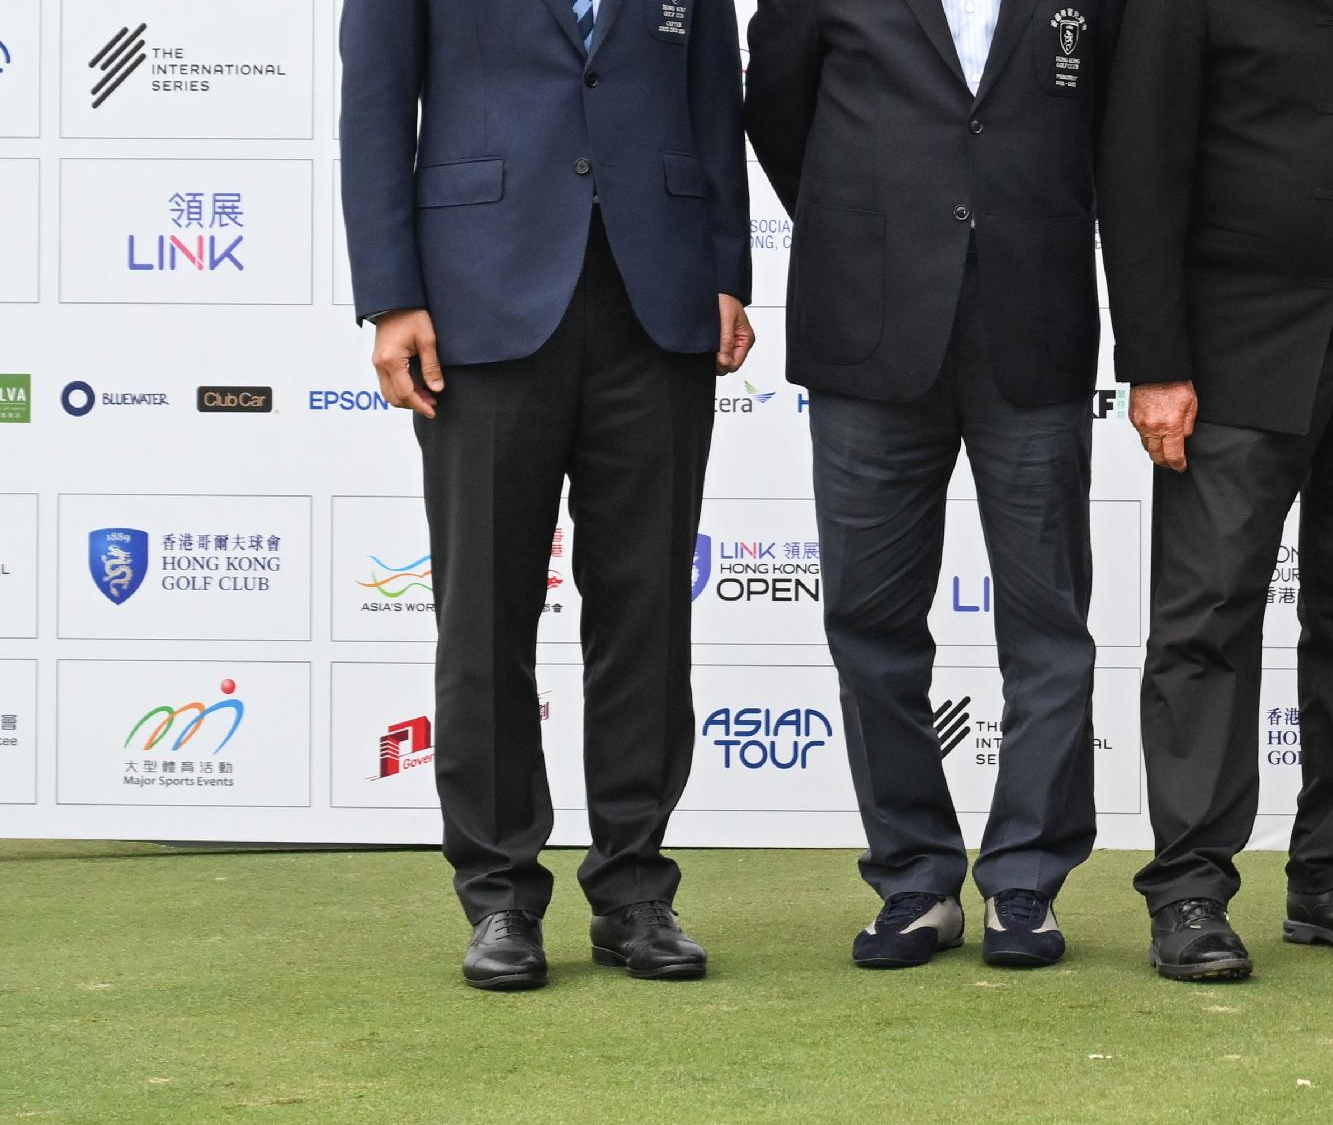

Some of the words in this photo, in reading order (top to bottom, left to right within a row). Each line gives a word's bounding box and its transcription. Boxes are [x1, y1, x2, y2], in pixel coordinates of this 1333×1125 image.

[152, 48, 183, 59] THE
[152, 64, 286, 75] INTERNATIONAL
[152, 81, 209, 91] SERIES
[169, 193, 244, 228] 領展
[128, 235, 244, 271] LINK
[0, 390, 26, 402] LVA
[102, 393, 169, 405] BLUEWATER
[204, 391, 234, 407] Club
[238, 392, 266, 407] Car
[106, 533, 131, 542] 1889
[161, 533, 280, 551] 香港哥爾夫球會
[721, 542, 775, 559] LINK
[162, 556, 219, 571] HONG
[225, 557, 280, 571] KONG
[720, 563, 769, 574] HONG
[162, 576, 213, 590] GOLF
[219, 576, 269, 590] CLUB
[361, 603, 402, 611] ASIA'S
[405, 603, 432, 612] WOR
[702, 708, 832, 737] ASIAN
[714, 740, 825, 769] TOUR
[125, 760, 232, 773] 大型體育活動
[124, 776, 156, 787] Major
[159, 776, 195, 787] Sports
[197, 777, 234, 786] Events
